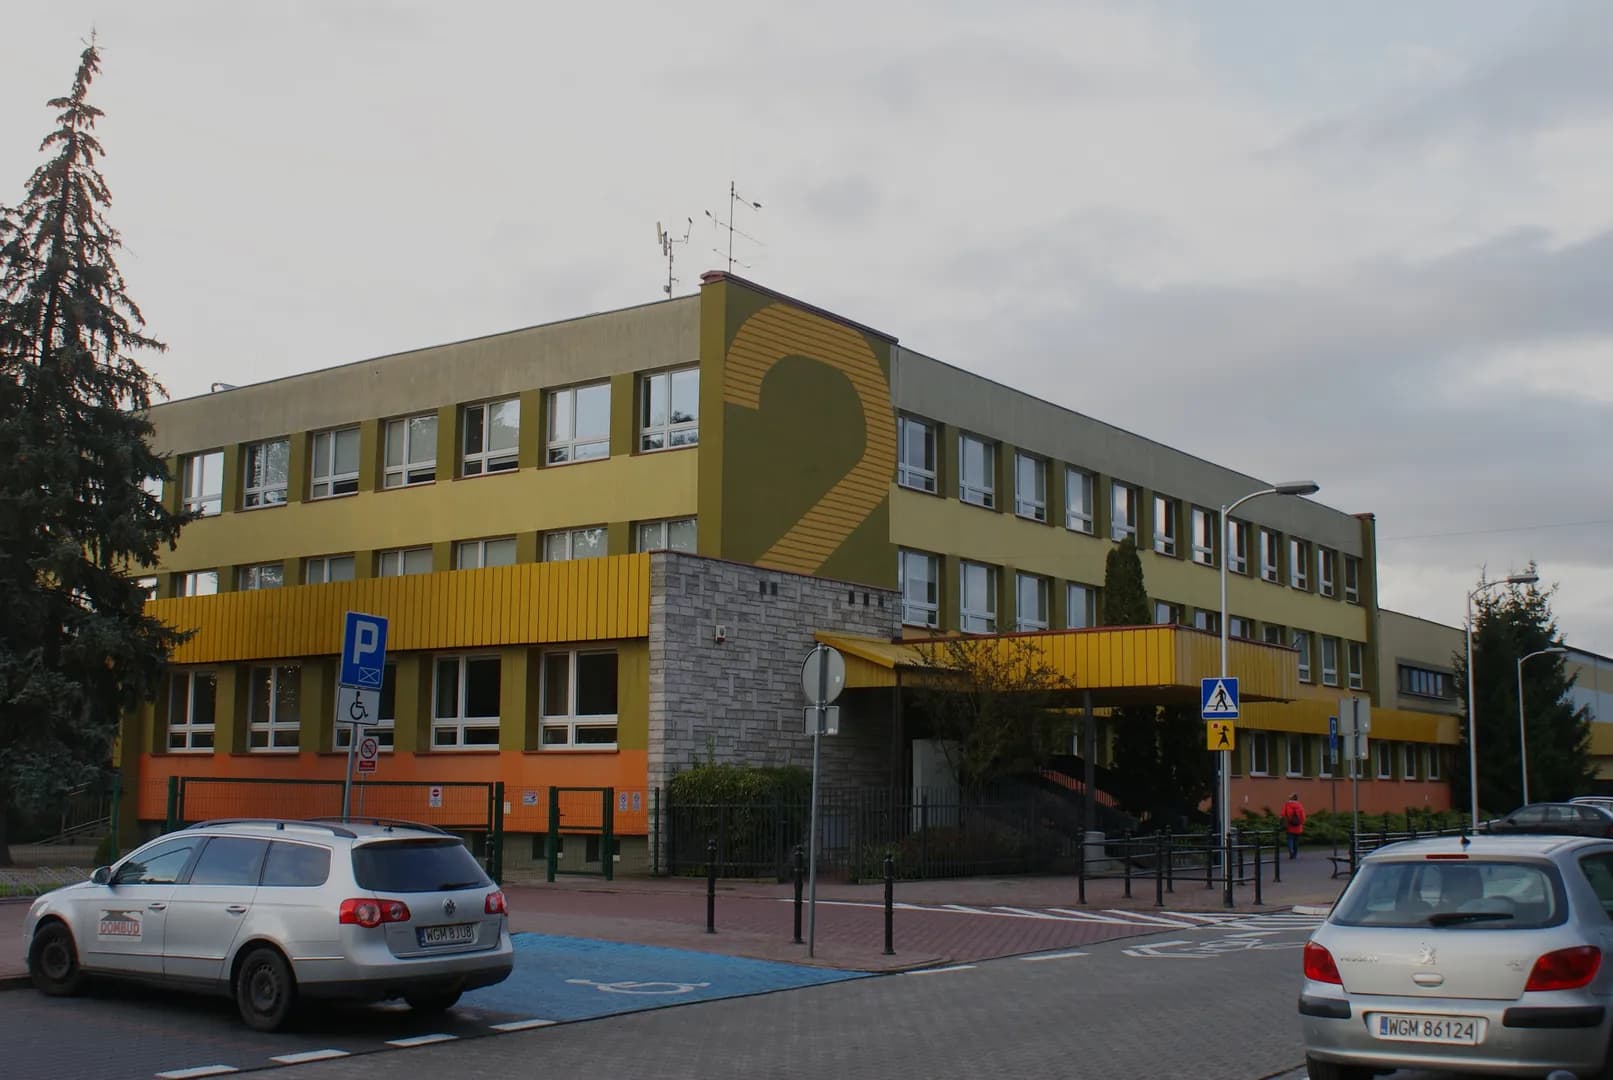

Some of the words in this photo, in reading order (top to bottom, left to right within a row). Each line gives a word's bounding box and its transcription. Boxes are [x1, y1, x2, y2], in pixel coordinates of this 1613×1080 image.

[723, 303, 896, 576] 2
[354, 621, 379, 664] P
[101, 921, 140, 934] DOMBUD
[427, 926, 448, 941] WGM
[1389, 1018, 1418, 1037] WGM
[1423, 1020, 1475, 1041] 86124
